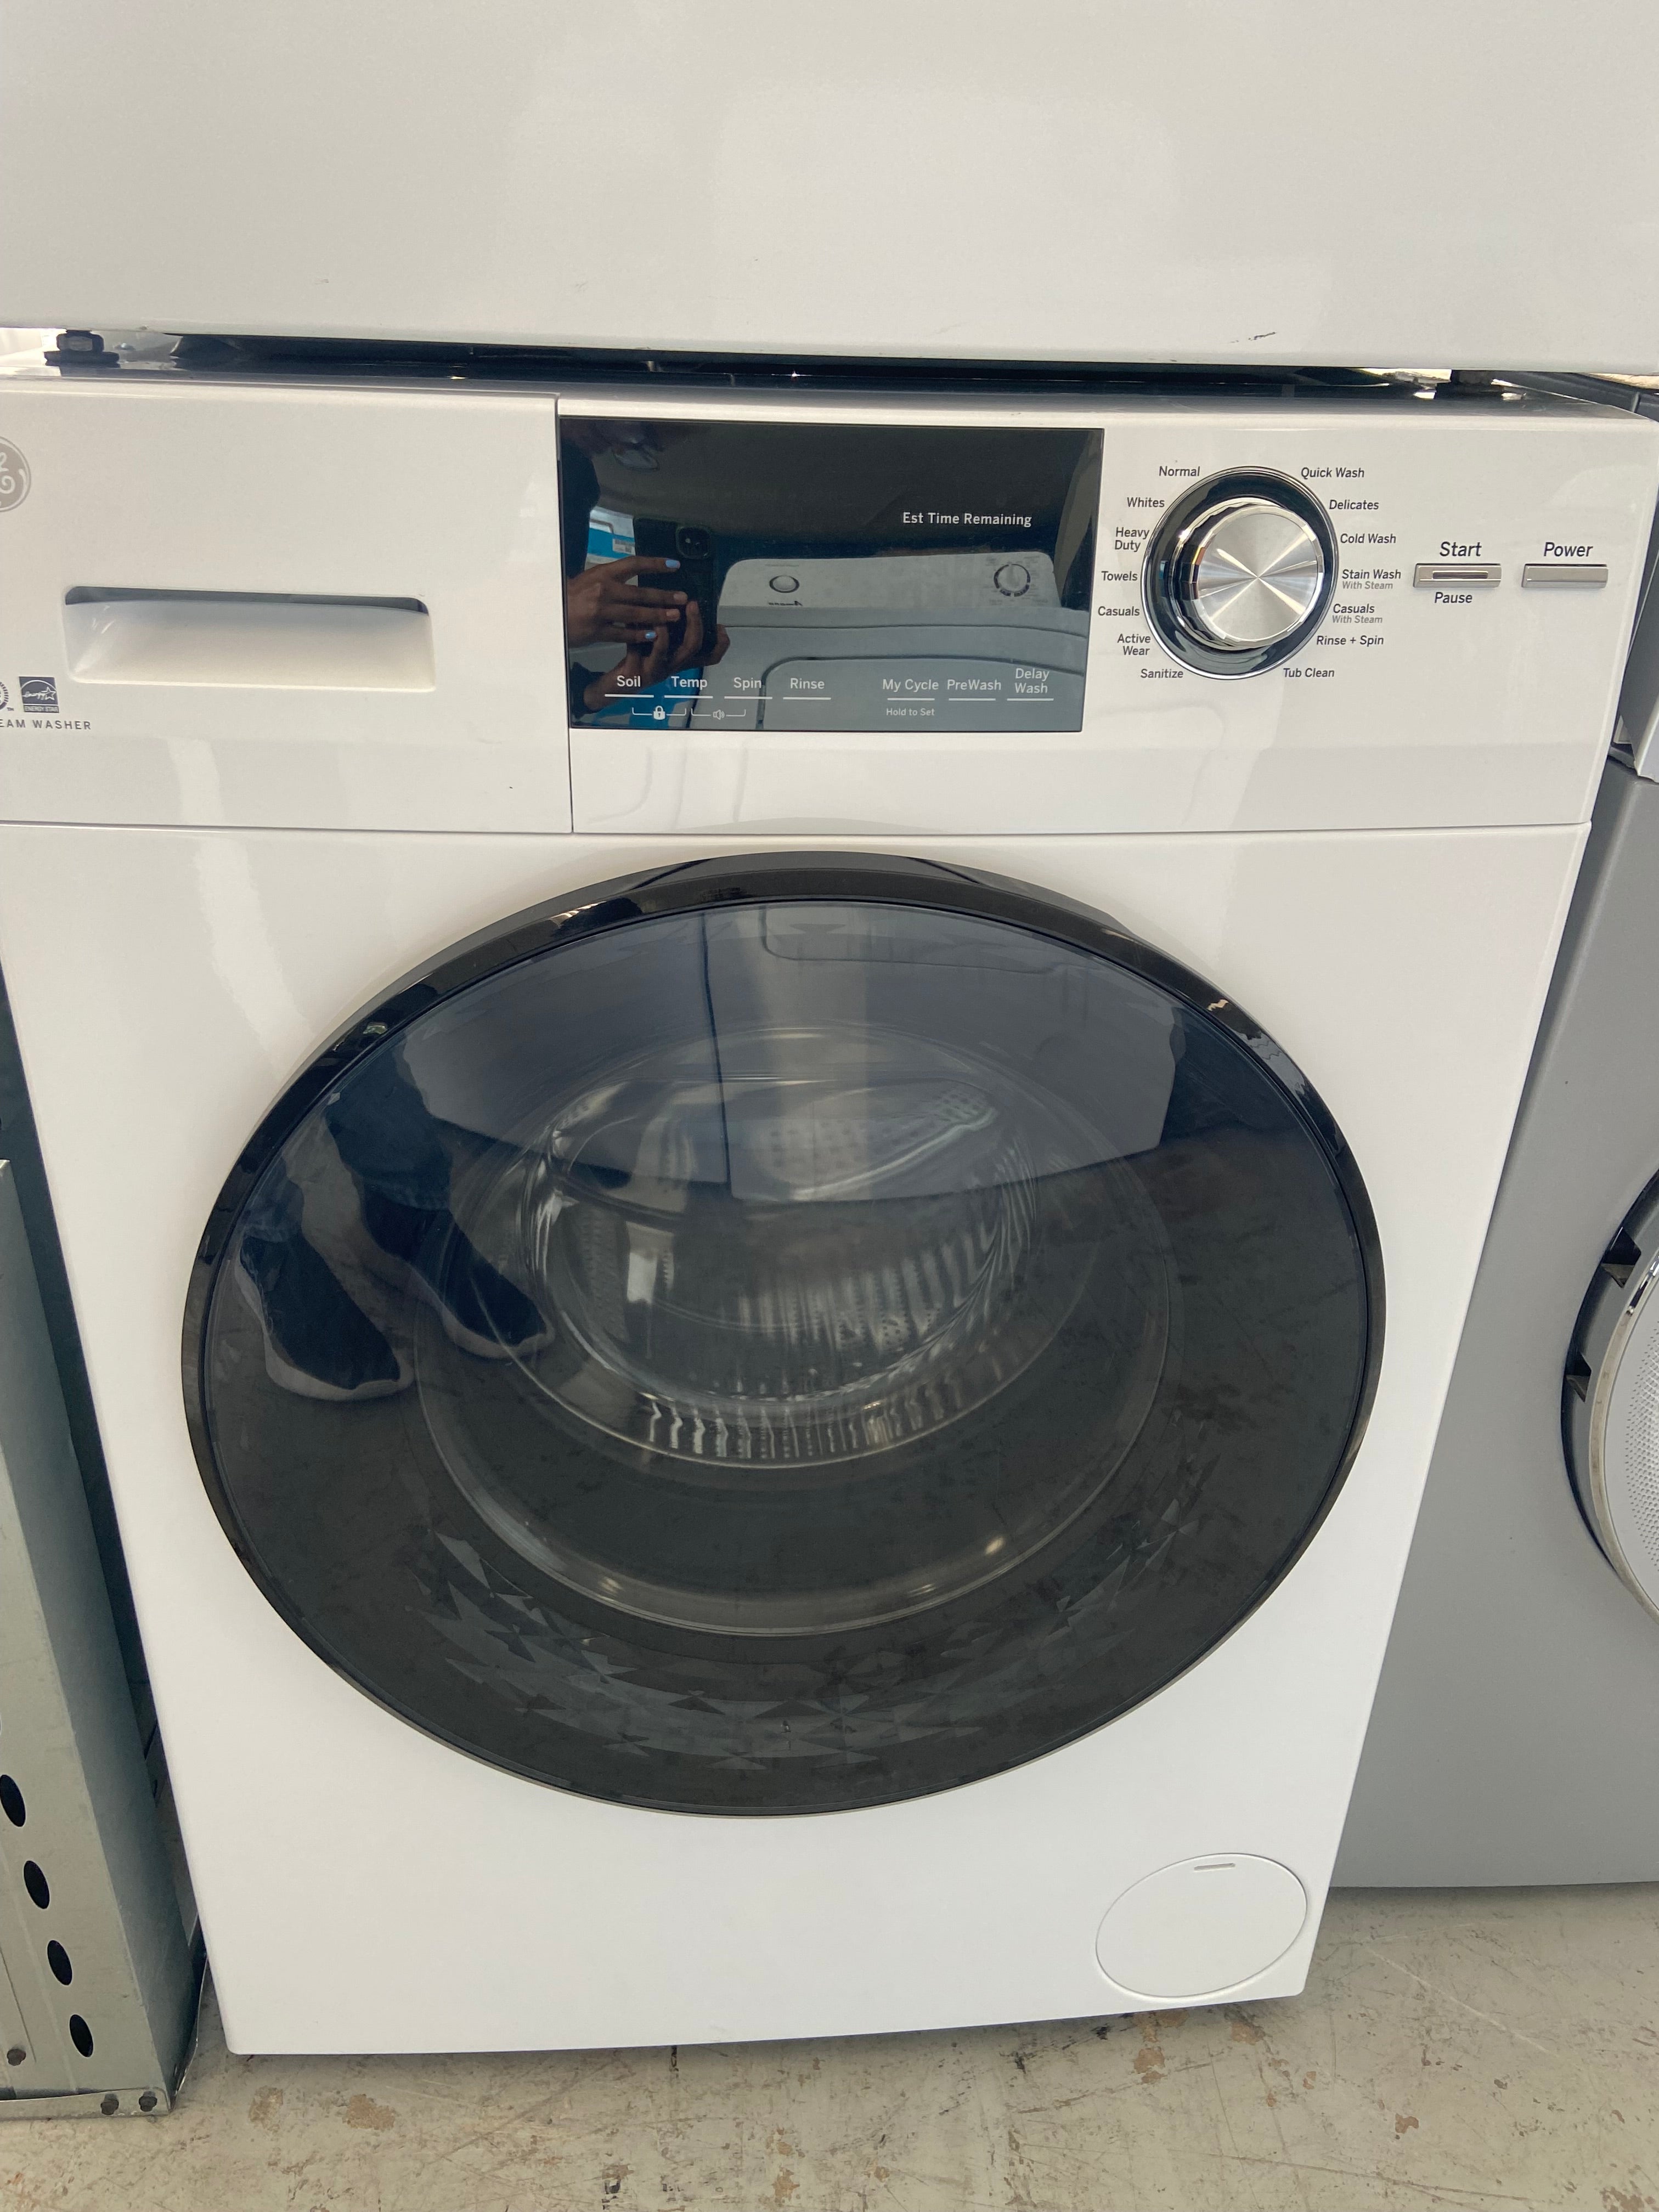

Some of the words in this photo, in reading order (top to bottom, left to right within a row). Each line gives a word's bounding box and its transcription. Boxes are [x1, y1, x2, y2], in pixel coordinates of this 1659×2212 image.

[1158, 465, 1201, 477] Normal
[1300, 466, 1333, 479] Quick
[1333, 467, 1365, 478] Wash
[1126, 496, 1165, 509] Whites
[1328, 499, 1380, 511] Delicates
[903, 512, 924, 523] Est
[928, 512, 960, 524] Time
[964, 512, 1032, 528] Remaining
[1115, 526, 1150, 540] Heavy
[1340, 533, 1365, 544] Cold
[1368, 533, 1396, 544] Wash
[1114, 539, 1141, 552] Duty
[1439, 541, 1482, 557] Start
[1543, 541, 1594, 557] Power
[1101, 571, 1138, 581] Towels
[1341, 569, 1370, 579] Stain
[1373, 569, 1401, 579] Wash
[1342, 580, 1362, 589] With
[1364, 580, 1393, 590] Steam
[1435, 591, 1472, 603] Pause
[1098, 606, 1140, 616] Casuals
[1332, 603, 1375, 614] Casuals
[1331, 614, 1352, 624] With
[1353, 614, 1384, 624] Steam
[1116, 633, 1152, 644] Active
[1316, 635, 1346, 646] Rinse
[1359, 635, 1384, 647] Spin
[1122, 645, 1150, 656] Wear
[1014, 667, 1051, 682] Delay
[1139, 667, 1184, 679] Sanitize
[1283, 668, 1302, 678] Tub
[1305, 668, 1335, 678] Clean
[617, 675, 641, 687] Soil
[670, 676, 708, 691] Temp
[733, 677, 761, 691] Spin
[790, 678, 825, 690] Rinse
[882, 679, 901, 693] My
[905, 679, 939, 693] Cycle
[947, 679, 1002, 690] PreWash
[1014, 682, 1049, 694] Wash
[886, 708, 906, 716] Hold
[920, 708, 935, 716] Set
[32, 719, 92, 730] WASHER
